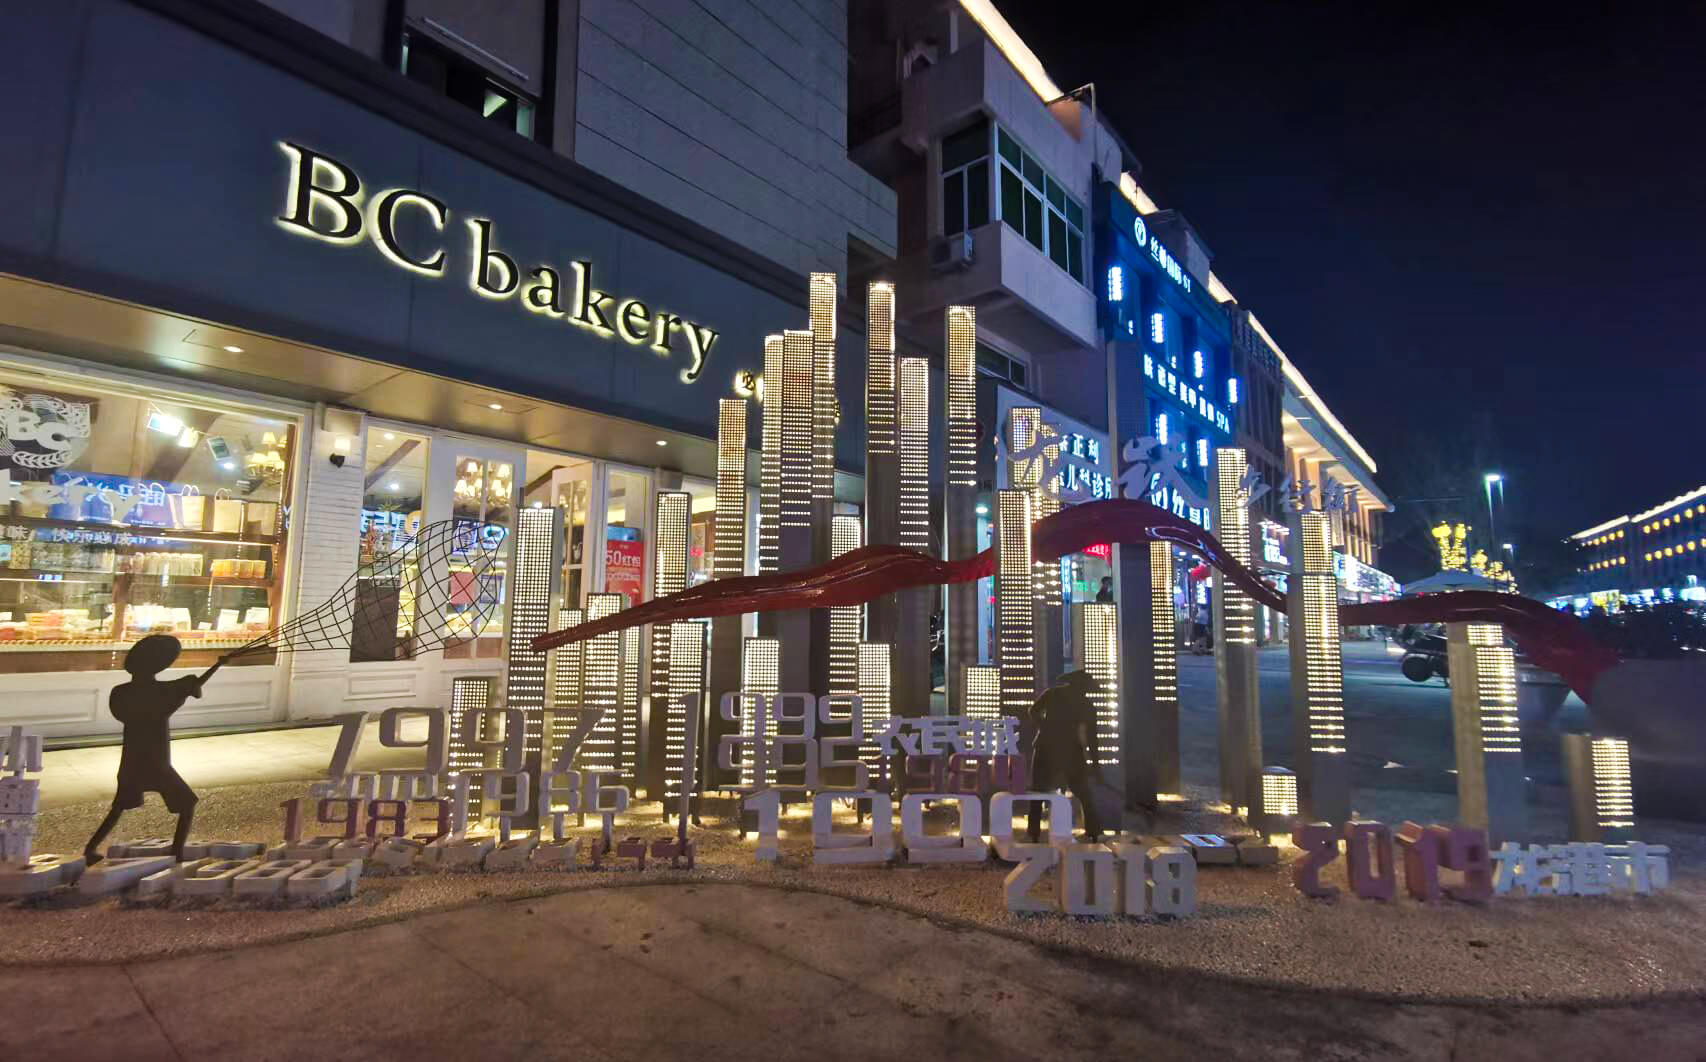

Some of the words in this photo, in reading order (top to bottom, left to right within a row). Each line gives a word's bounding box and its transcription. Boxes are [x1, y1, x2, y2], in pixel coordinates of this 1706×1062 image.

[275, 141, 449, 276] BC
[465, 217, 720, 383] bakery
[1216, 410, 1230, 434] SPA
[1004, 842, 1198, 915] 2018
[1292, 820, 1490, 900] 2019
